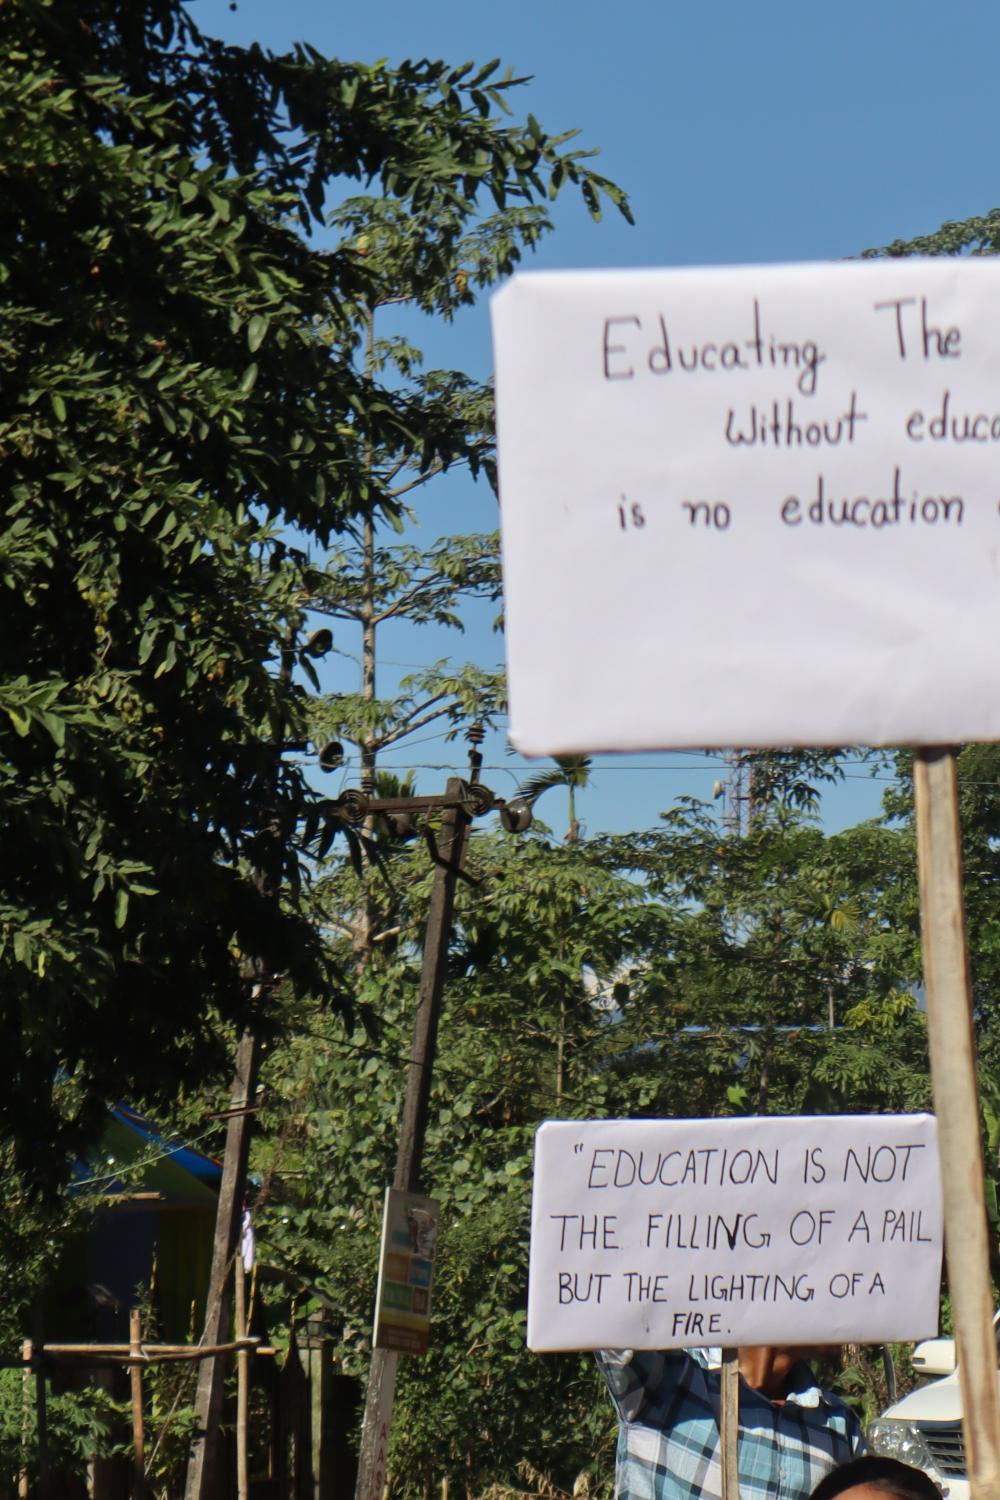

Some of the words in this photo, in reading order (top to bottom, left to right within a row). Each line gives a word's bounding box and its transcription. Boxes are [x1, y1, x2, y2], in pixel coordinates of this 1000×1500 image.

[602, 297, 826, 395] Educating
[874, 295, 962, 359] The
[617, 493, 646, 530] is
[682, 500, 731, 530] no
[780, 466, 965, 528] education
[804, 1147, 825, 1184] IS
[843, 1144, 926, 1184] NOT
[550, 1214, 619, 1251] THE
[646, 1213, 771, 1250] FILLING
[789, 1210, 836, 1246] OF
[848, 1210, 871, 1244] A
[882, 1210, 932, 1243] PAIL
[558, 1272, 612, 1304] BUT
[623, 1272, 668, 1302] THE
[689, 1273, 815, 1302] LIGHTING
[829, 1274, 863, 1298] OF
[868, 1272, 886, 1295] A
[671, 1312, 732, 1337] FIRE.
